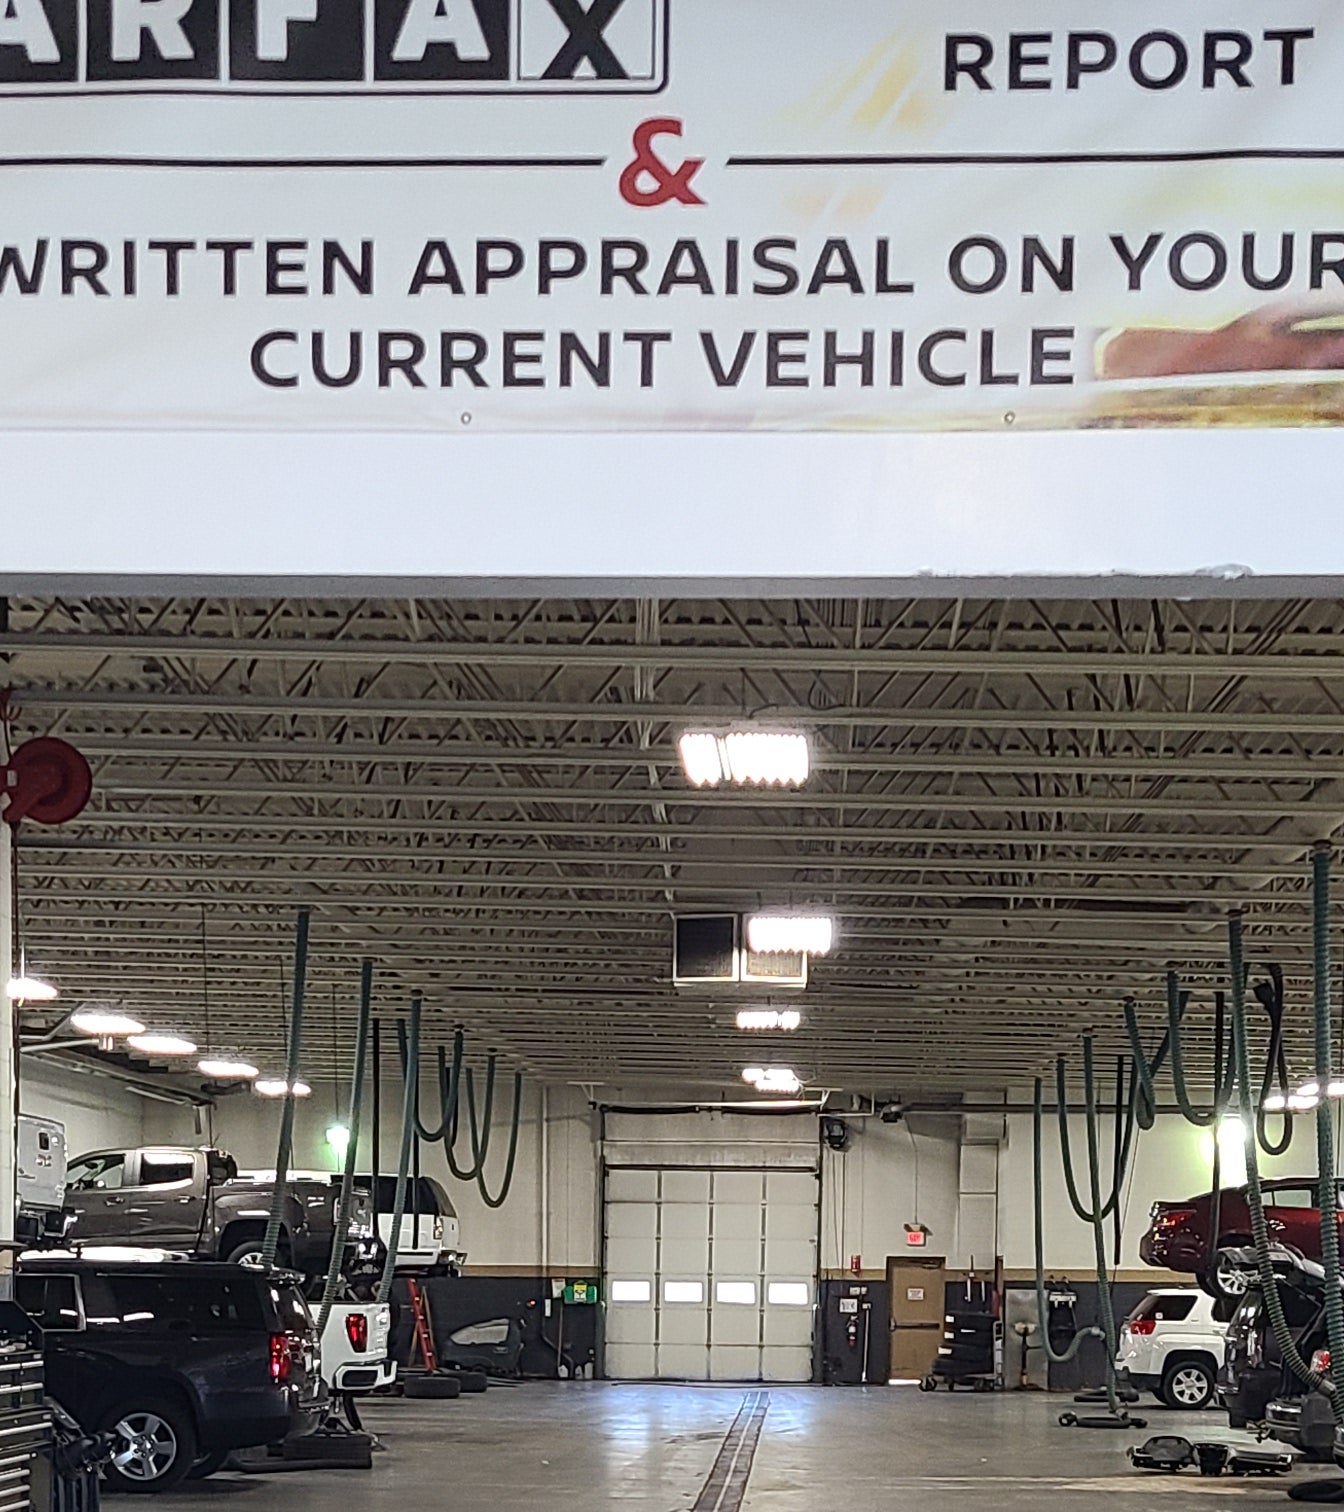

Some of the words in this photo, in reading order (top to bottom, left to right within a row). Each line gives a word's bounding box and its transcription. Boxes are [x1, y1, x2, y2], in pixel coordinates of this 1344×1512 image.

[943, 28, 1315, 91] REPORT
[618, 116, 707, 207] &
[408, 234, 915, 297] APPRAISAL
[948, 236, 1076, 295] ON
[250, 330, 671, 389] CURRENT
[700, 327, 1076, 388] VEHICLE
